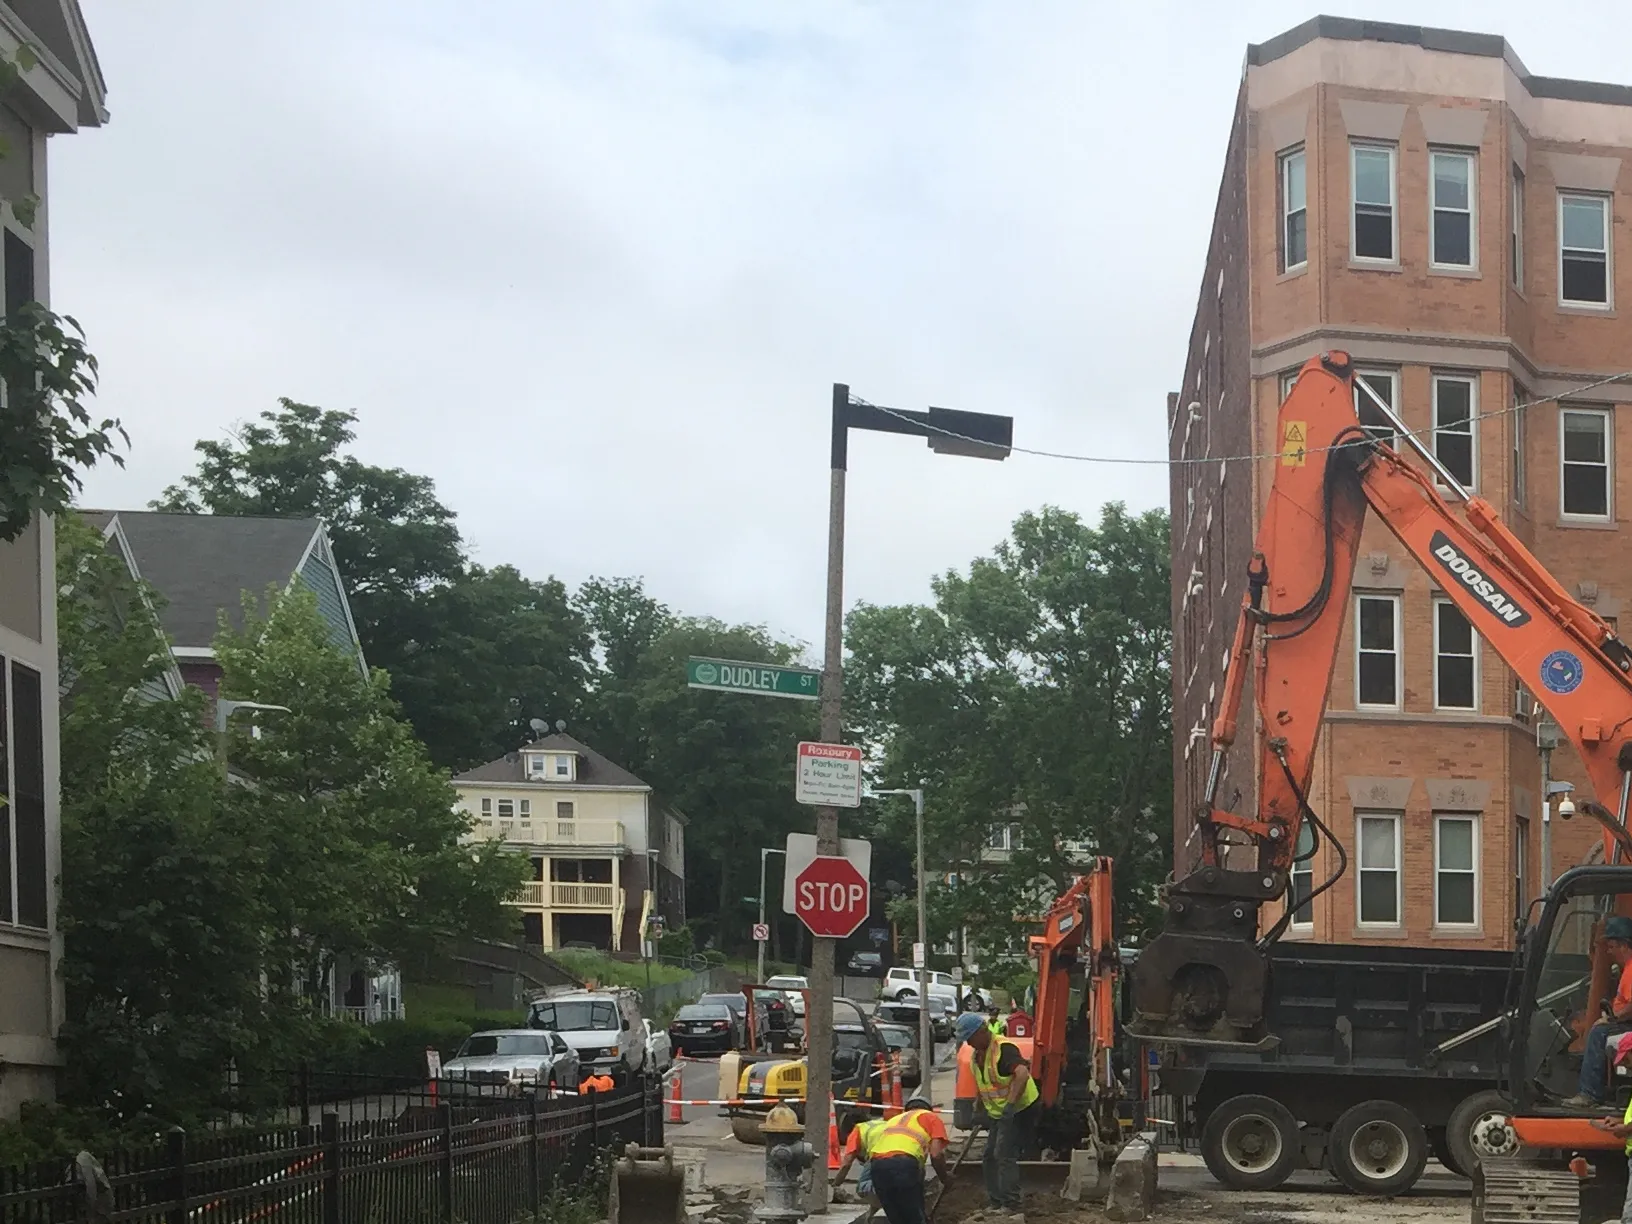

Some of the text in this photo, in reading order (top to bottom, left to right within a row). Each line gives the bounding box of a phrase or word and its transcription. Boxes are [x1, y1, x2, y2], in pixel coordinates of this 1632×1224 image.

[1435, 544, 1522, 622] DOOSAN
[720, 666, 780, 690] DUDLEY
[800, 674, 813, 687] ST
[807, 745, 853, 759] Roxbury
[811, 759, 850, 772] Parking
[800, 881, 864, 913] STOP
